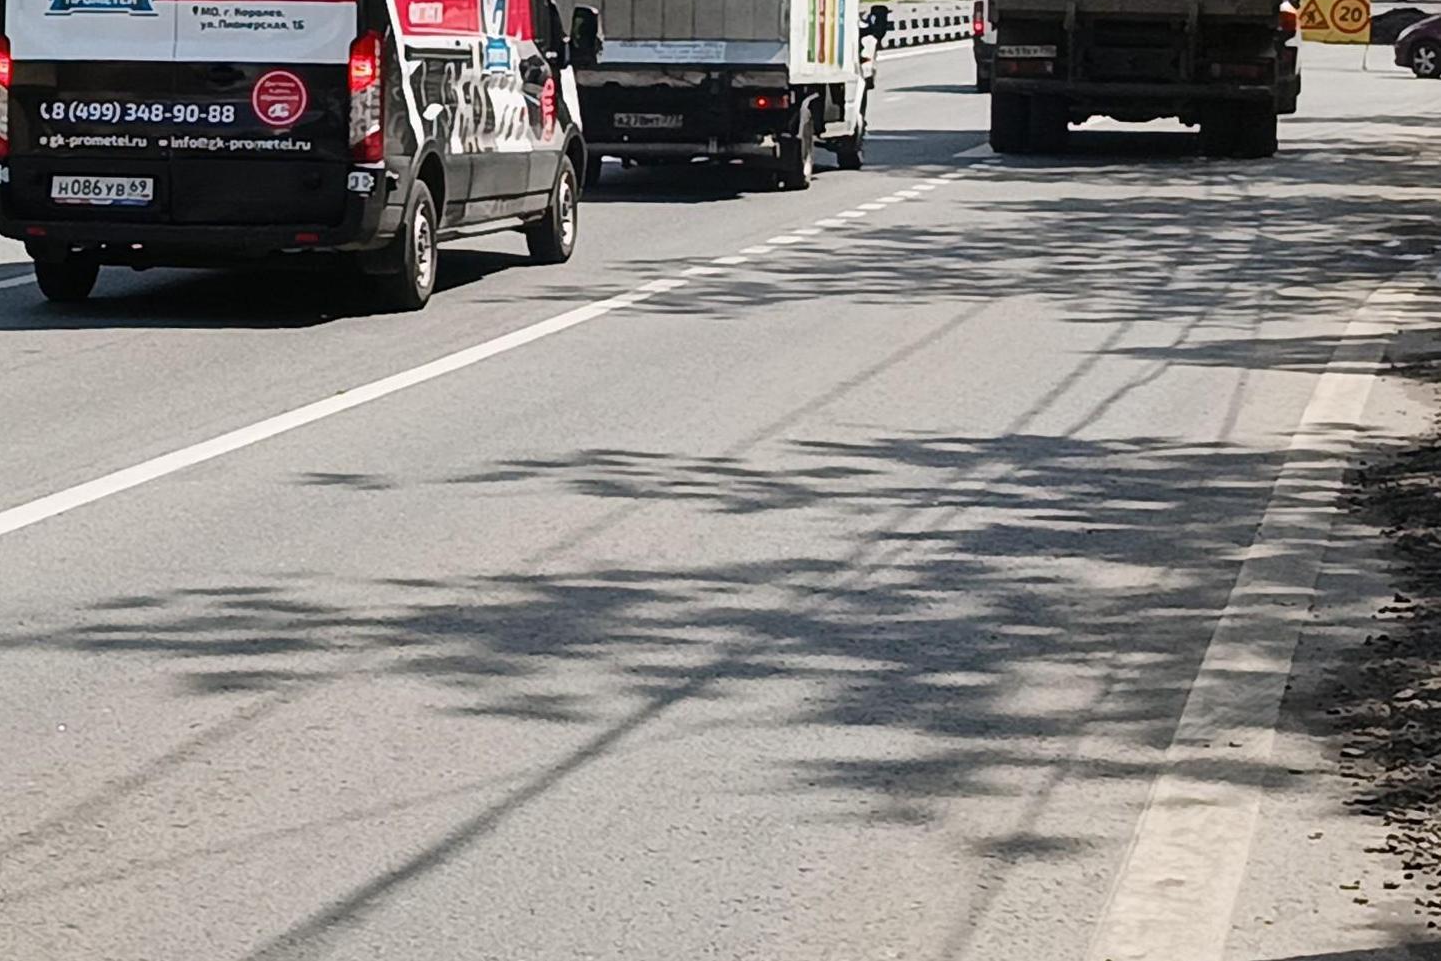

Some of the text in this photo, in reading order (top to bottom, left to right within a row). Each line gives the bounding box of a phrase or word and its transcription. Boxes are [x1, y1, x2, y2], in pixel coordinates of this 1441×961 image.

[1339, 6, 1362, 22] 20
[52, 101, 235, 123] 8 (499) 348-90-88
[49, 134, 148, 149] gk-prometei.ru
